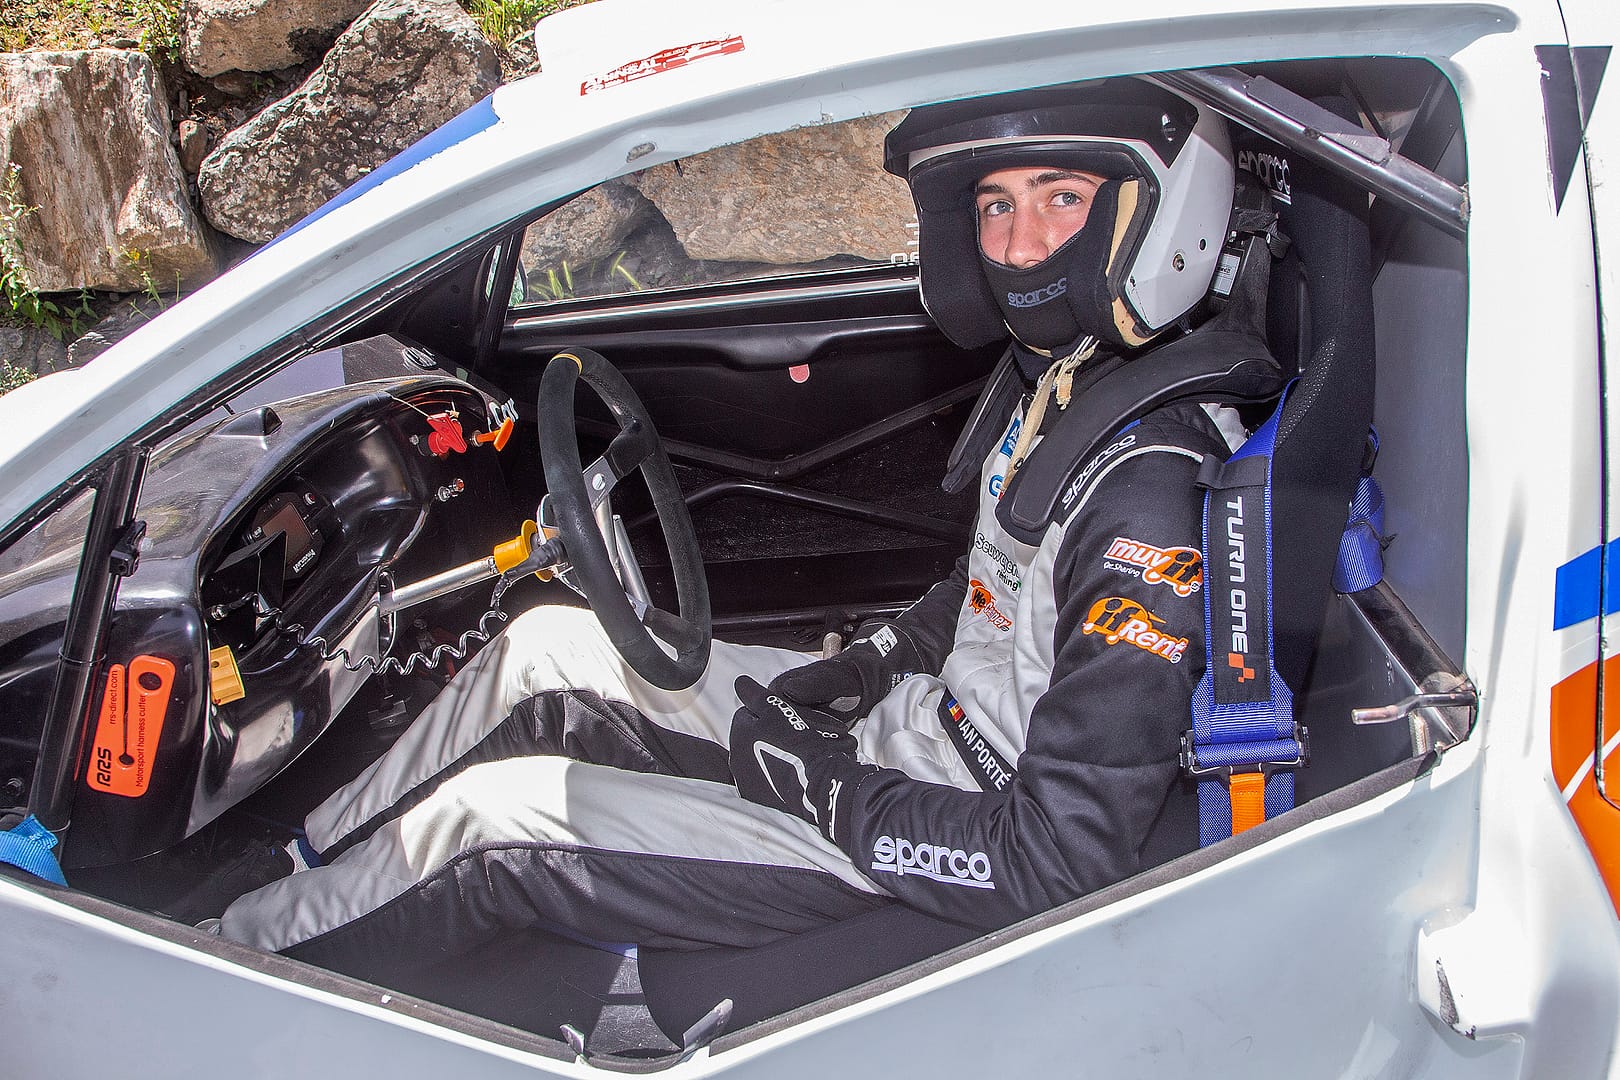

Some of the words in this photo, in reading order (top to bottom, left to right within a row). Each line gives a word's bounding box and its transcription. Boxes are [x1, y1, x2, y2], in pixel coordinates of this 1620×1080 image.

[1062, 434, 1136, 510] sparco
[1226, 496, 1246, 582] TURN
[1230, 589, 1249, 653] ONE
[136, 718, 145, 747] harness
[138, 694, 146, 716] cutter
[135, 748, 145, 787] Motorsport
[958, 716, 978, 745] IAN
[971, 738, 1012, 791] PORTÉ
[872, 835, 994, 887] sparco
